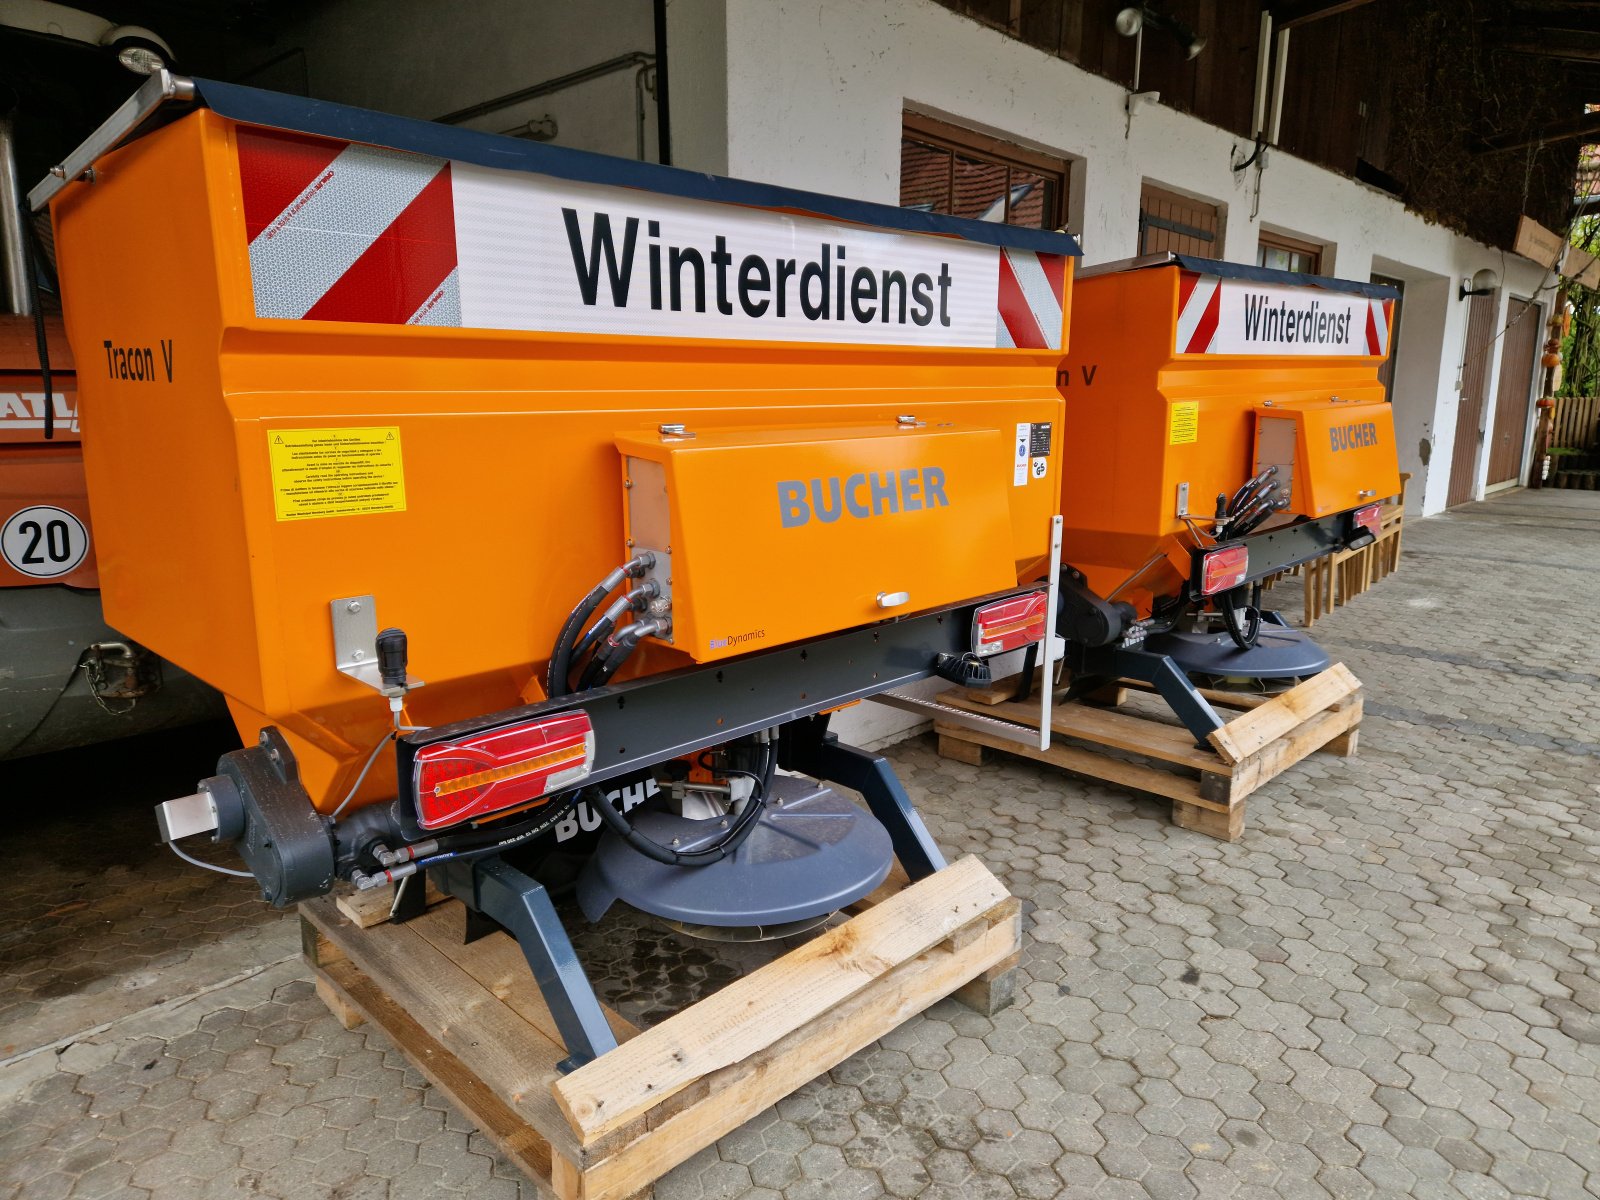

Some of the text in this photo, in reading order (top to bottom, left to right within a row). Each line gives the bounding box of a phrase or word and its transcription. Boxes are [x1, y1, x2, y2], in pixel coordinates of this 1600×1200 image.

[561, 206, 953, 328] Winterdienst
[1244, 293, 1352, 344] Winterdienst
[104, 339, 173, 383] Tracon V
[1082, 365, 1097, 387] V
[0, 392, 79, 418] ATL
[1329, 422, 1377, 453] BUCHER
[777, 466, 950, 529] BUCHER
[19, 519, 71, 565] 20
